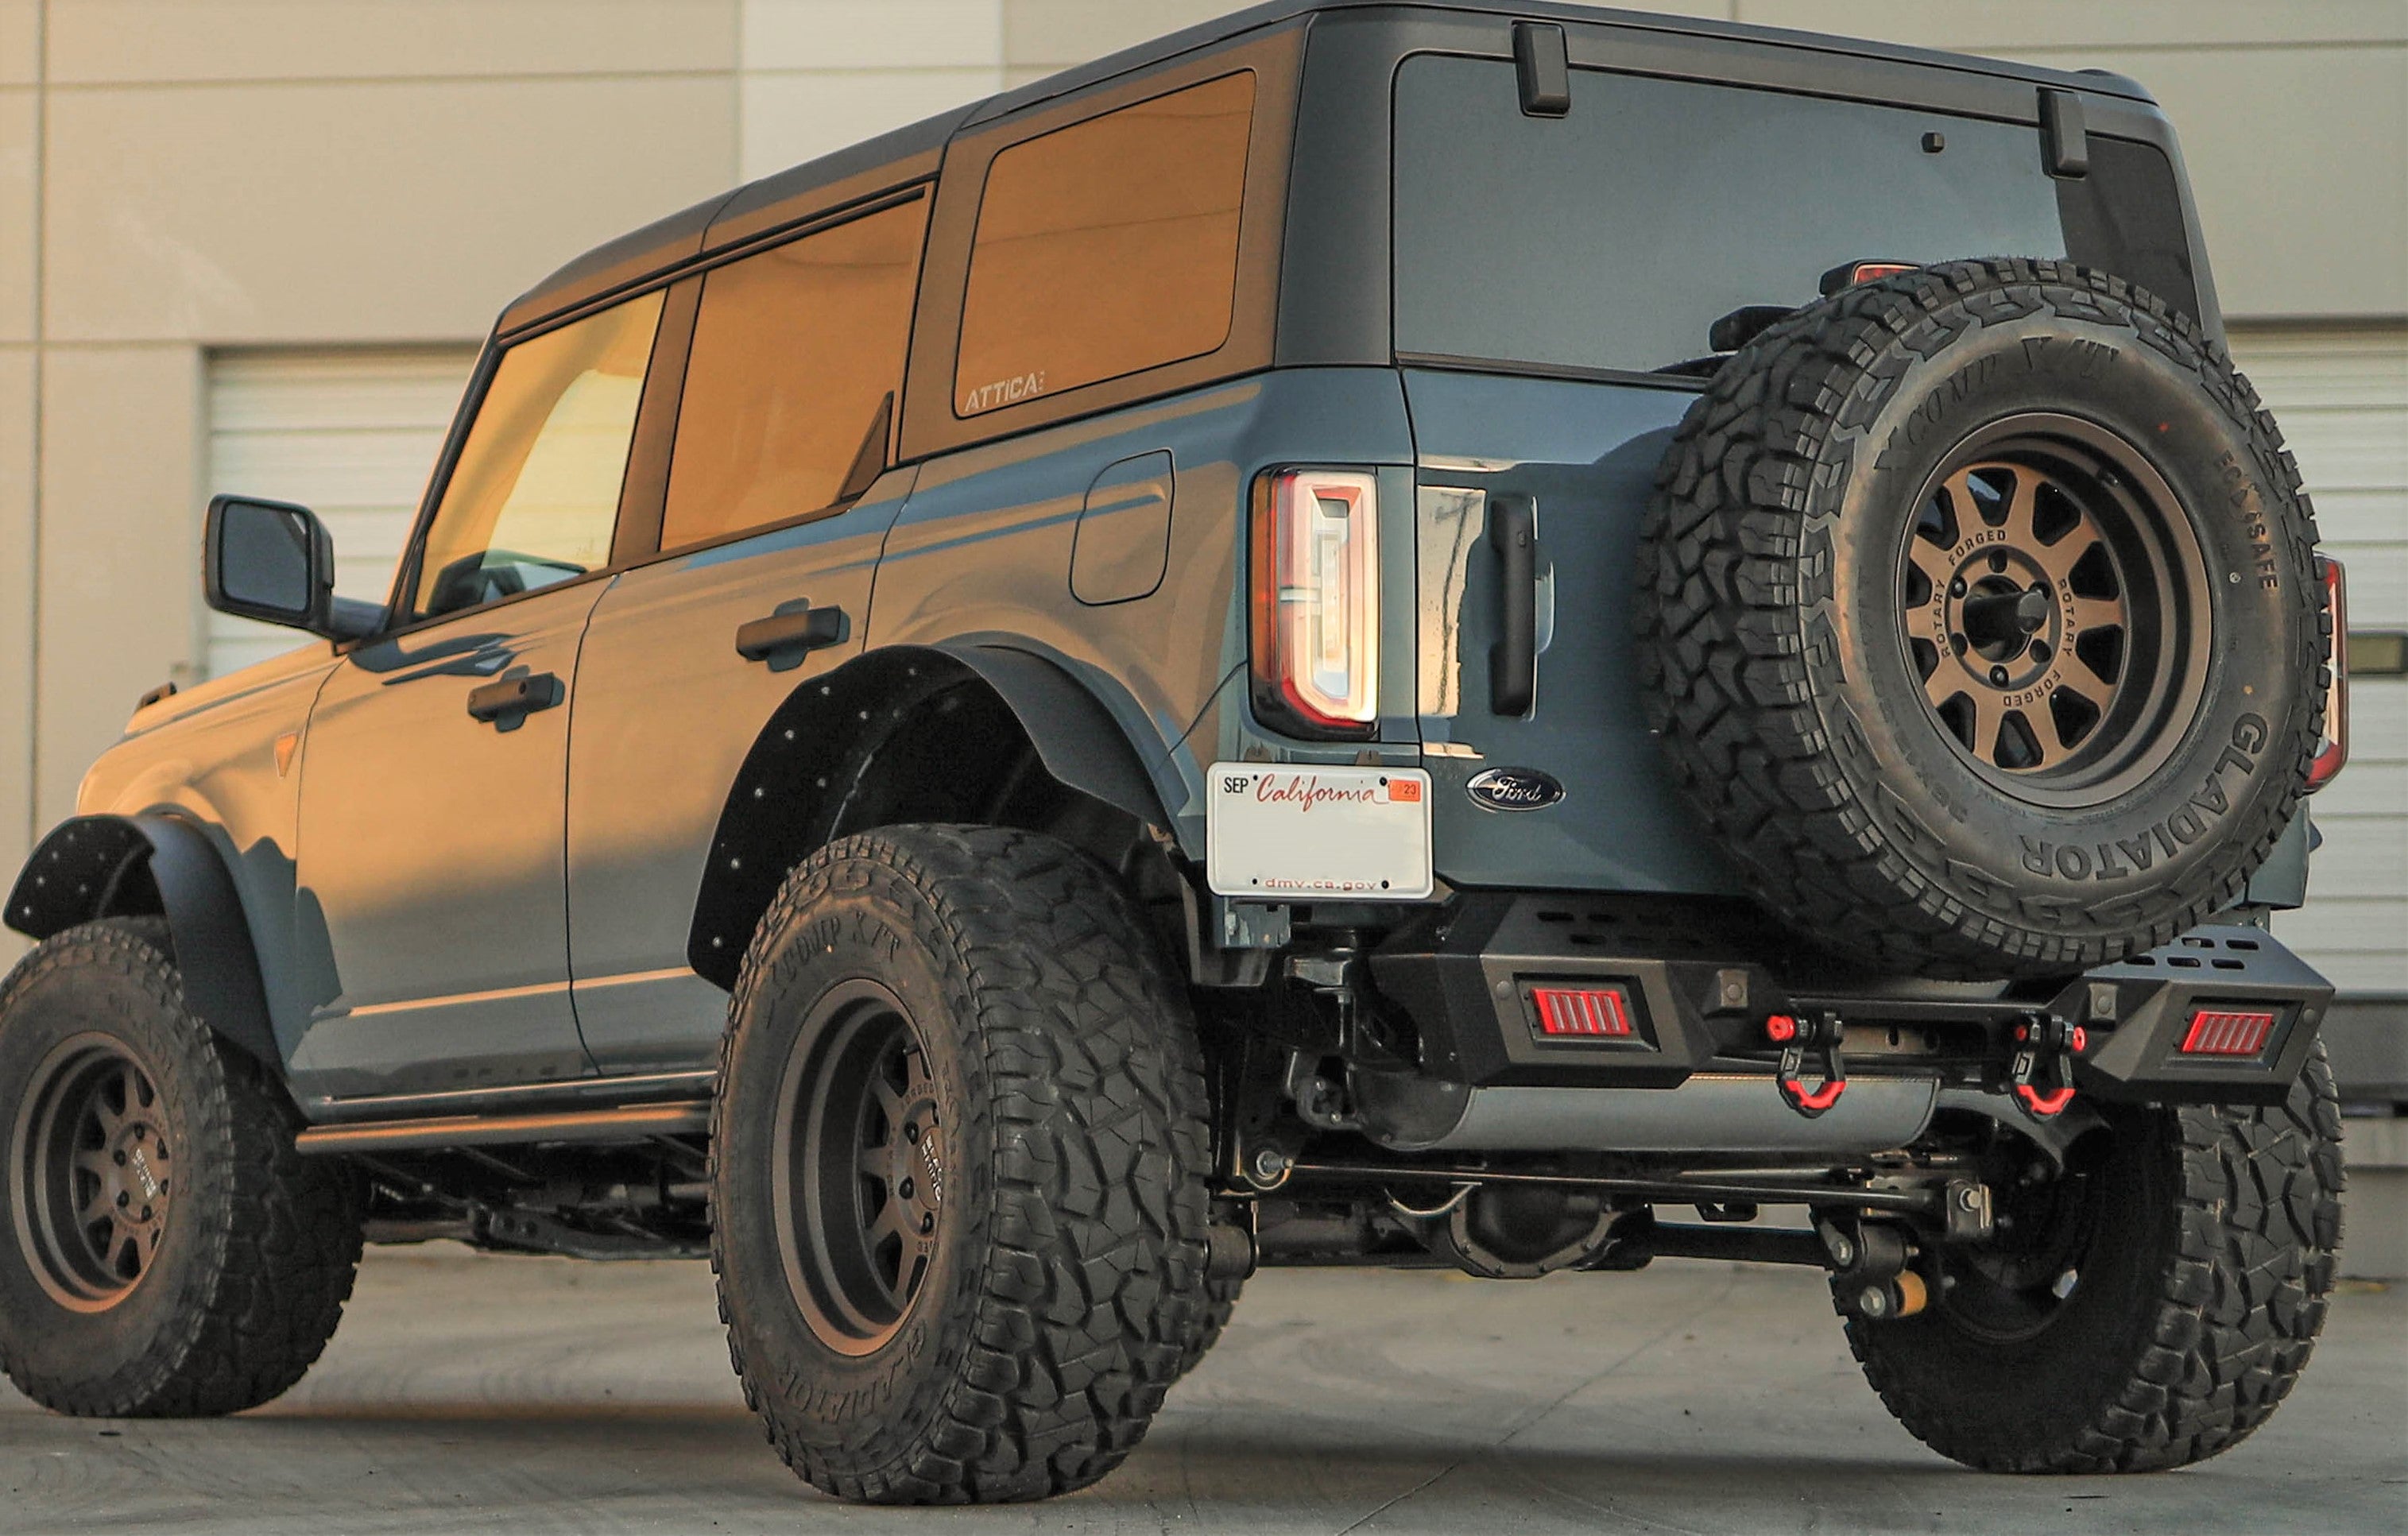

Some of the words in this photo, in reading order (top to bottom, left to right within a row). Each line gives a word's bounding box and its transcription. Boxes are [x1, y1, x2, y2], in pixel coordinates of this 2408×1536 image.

[1934, 579, 1950, 658] ROTARY
[1948, 530, 2006, 566] FORGED
[2057, 578, 2076, 656] ROTARY
[2003, 671, 2062, 707] FORGED
[1224, 777, 1249, 793] SEP
[1256, 774, 1389, 812] California
[1404, 784, 1416, 795] 23
[1492, 776, 1542, 800] Ford
[2022, 713, 2267, 880] GLADIATOR
[1264, 878, 1377, 891] dmv.ca.gov
